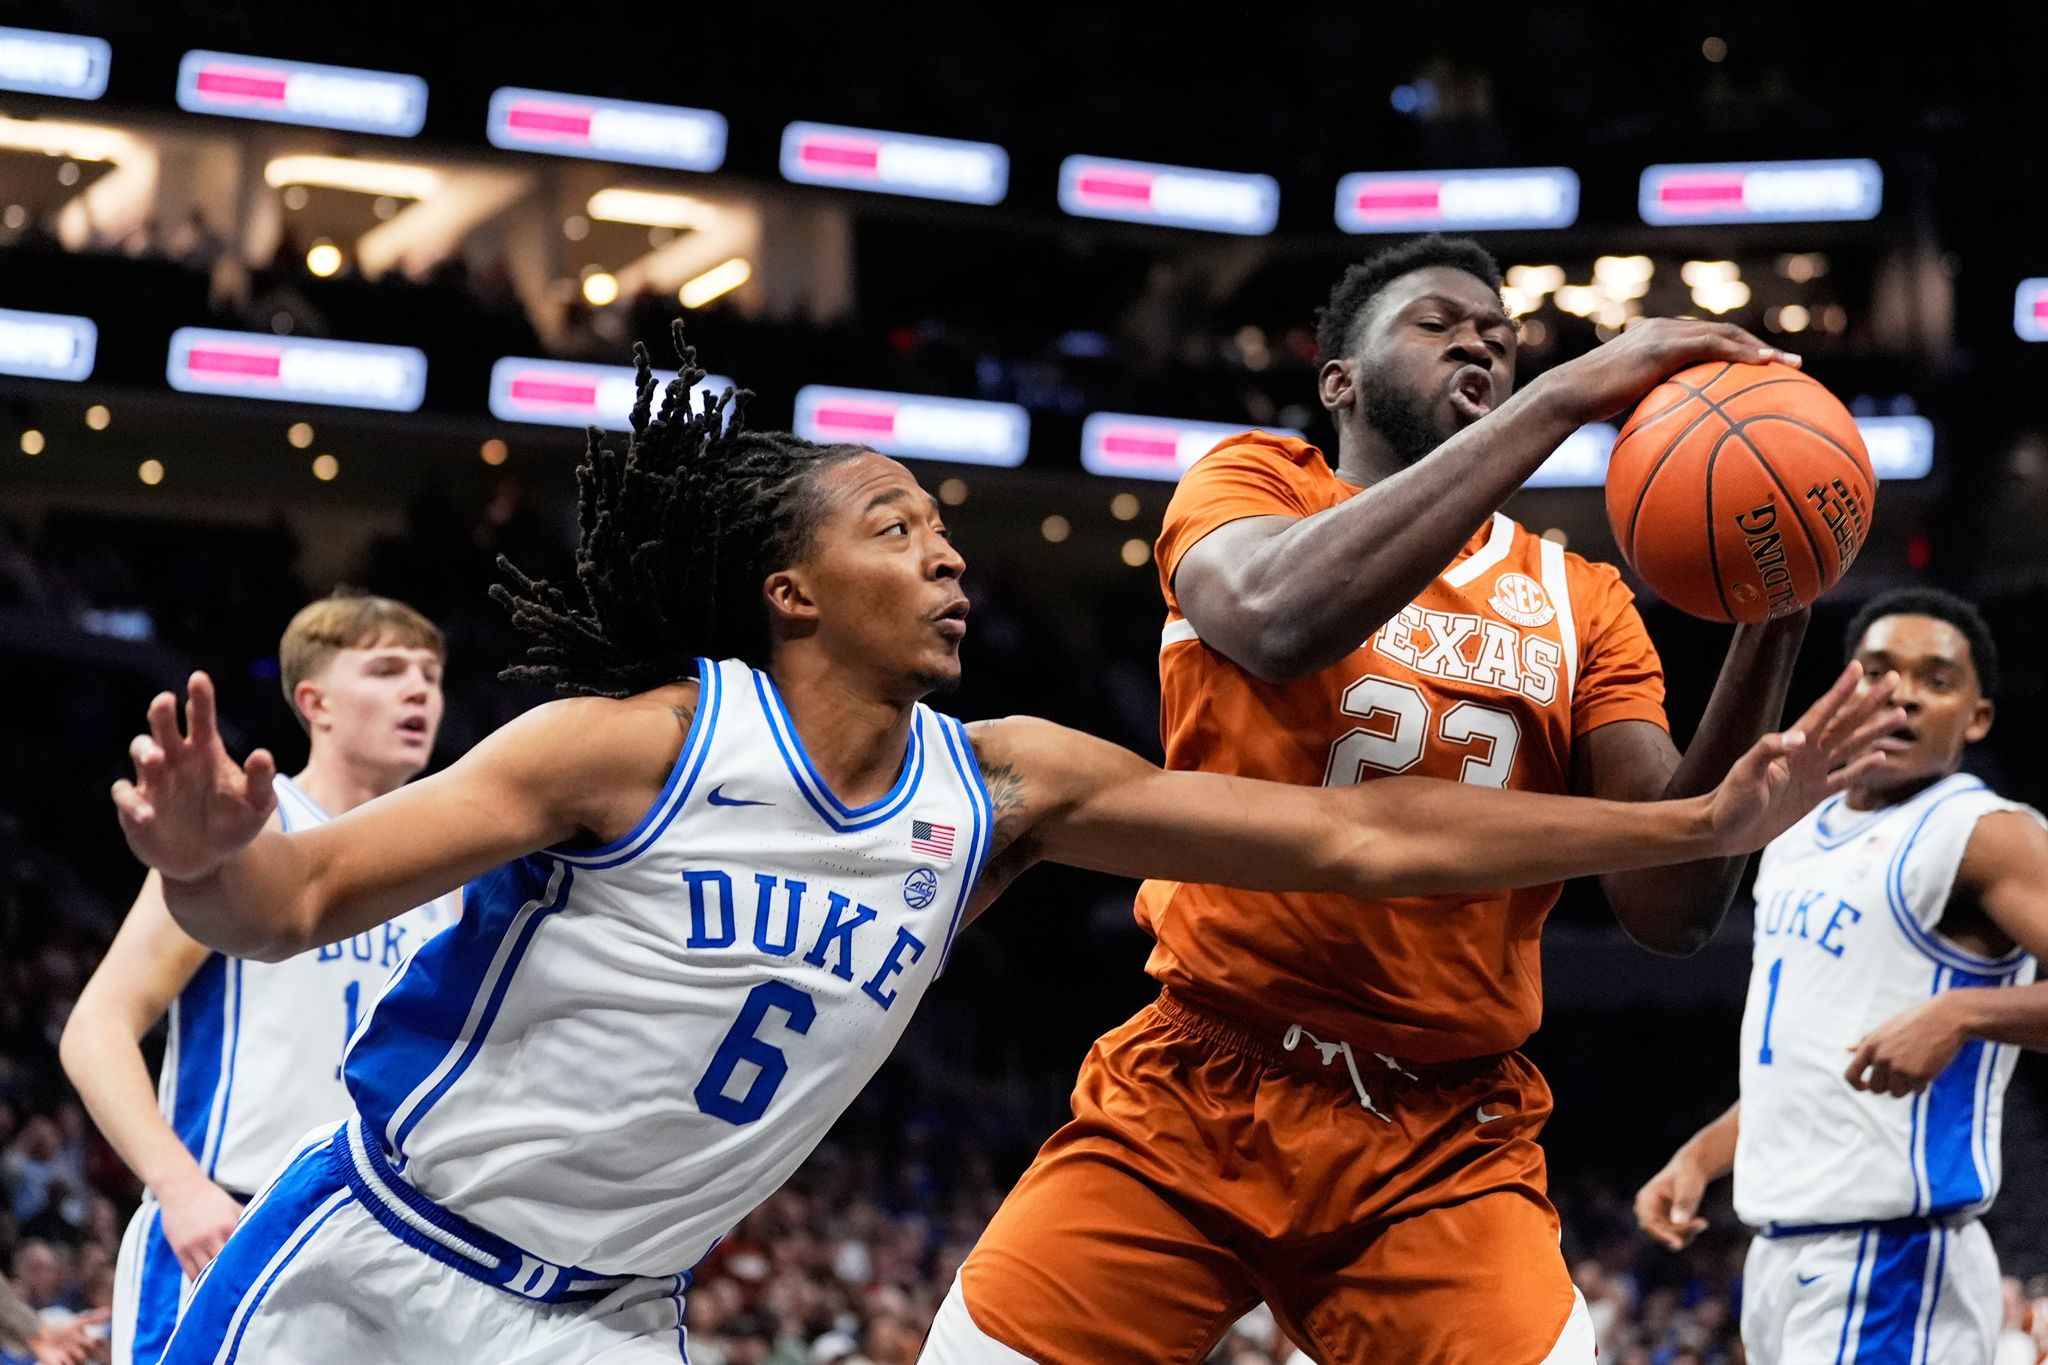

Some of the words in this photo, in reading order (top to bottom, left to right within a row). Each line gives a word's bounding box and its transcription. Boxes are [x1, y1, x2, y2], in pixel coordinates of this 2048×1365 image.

[1734, 502, 1798, 619] ALDING
[1805, 483, 1858, 575] EGACY
[1496, 606, 1548, 627] GRADUATE
[1498, 576, 1544, 613] SEC
[1360, 602, 1562, 707] EXAS
[1323, 673, 1522, 790] 23
[905, 880, 937, 897] ACC
[1755, 888, 1862, 959] UKE
[318, 921, 427, 968] UK
[682, 870, 926, 1012] DUKE
[693, 979, 817, 1126] 6
[1758, 957, 1783, 1066] 1
